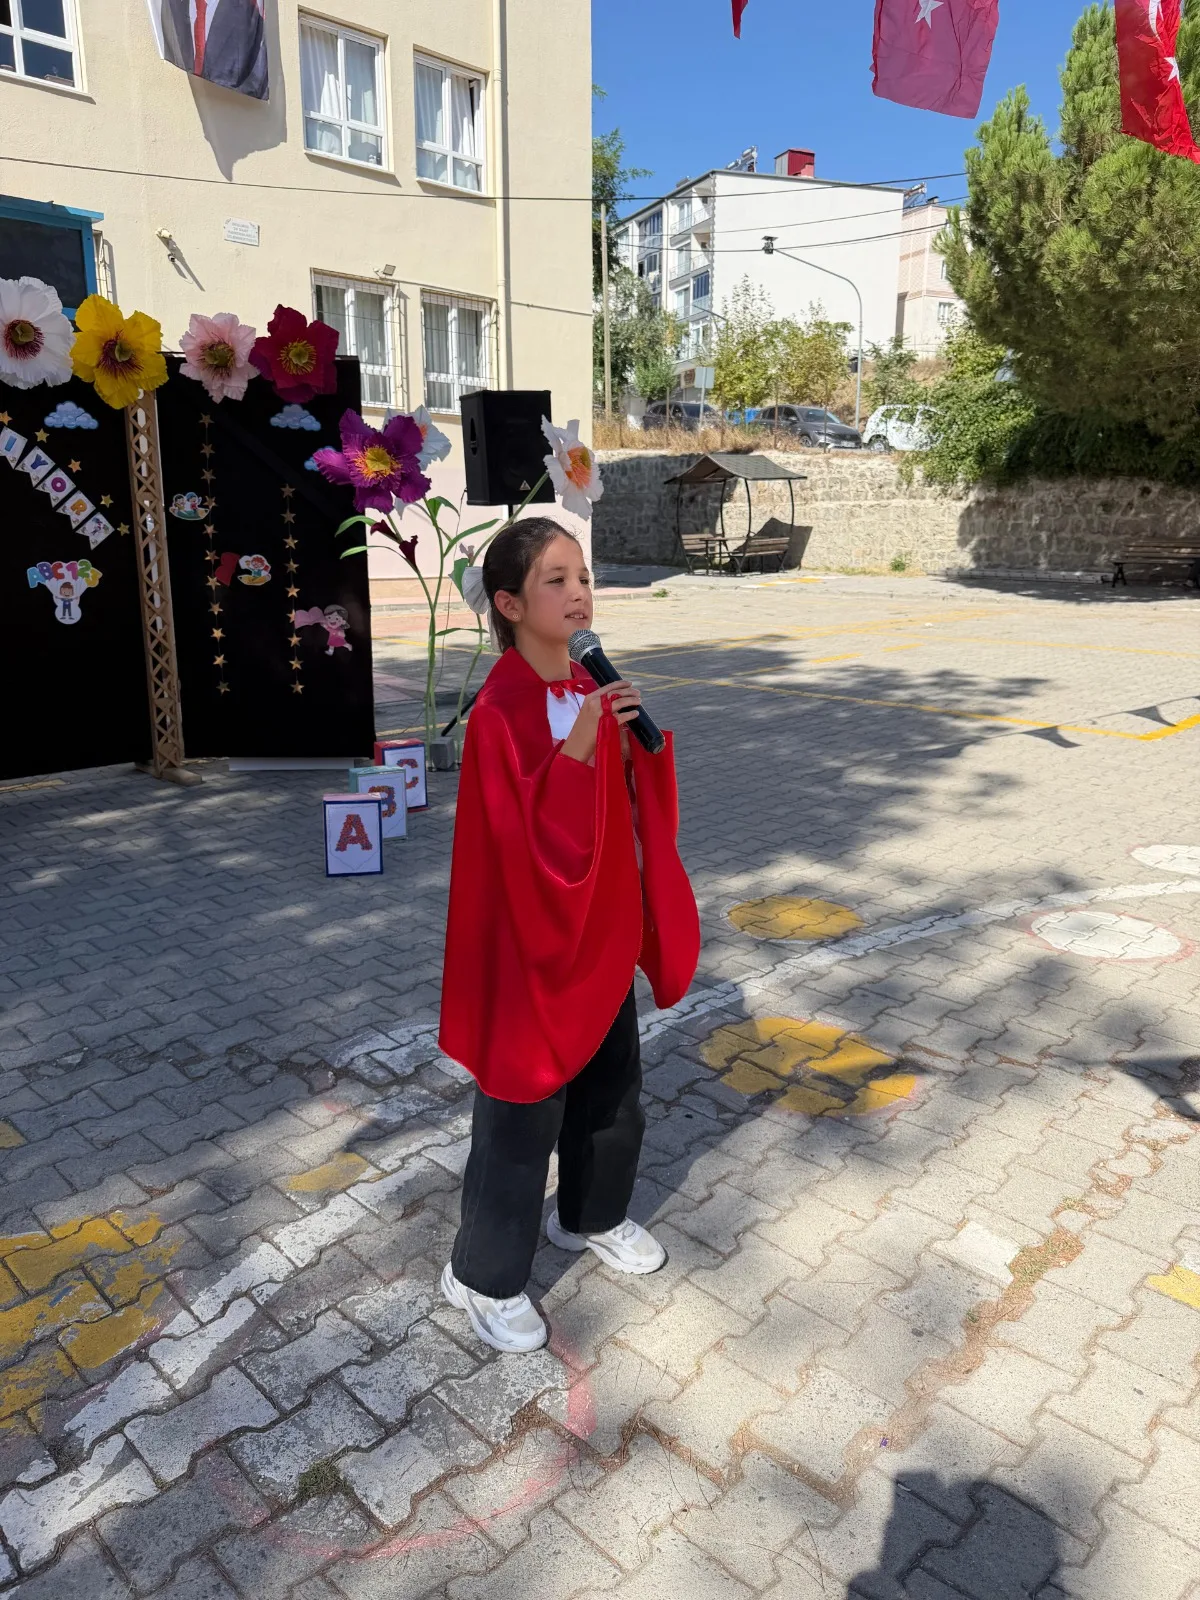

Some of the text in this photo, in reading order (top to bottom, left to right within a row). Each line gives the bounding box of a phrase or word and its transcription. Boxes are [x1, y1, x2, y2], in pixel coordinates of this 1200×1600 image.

[28, 560, 102, 588] ABC 123
[335, 758, 419, 852] A B C
